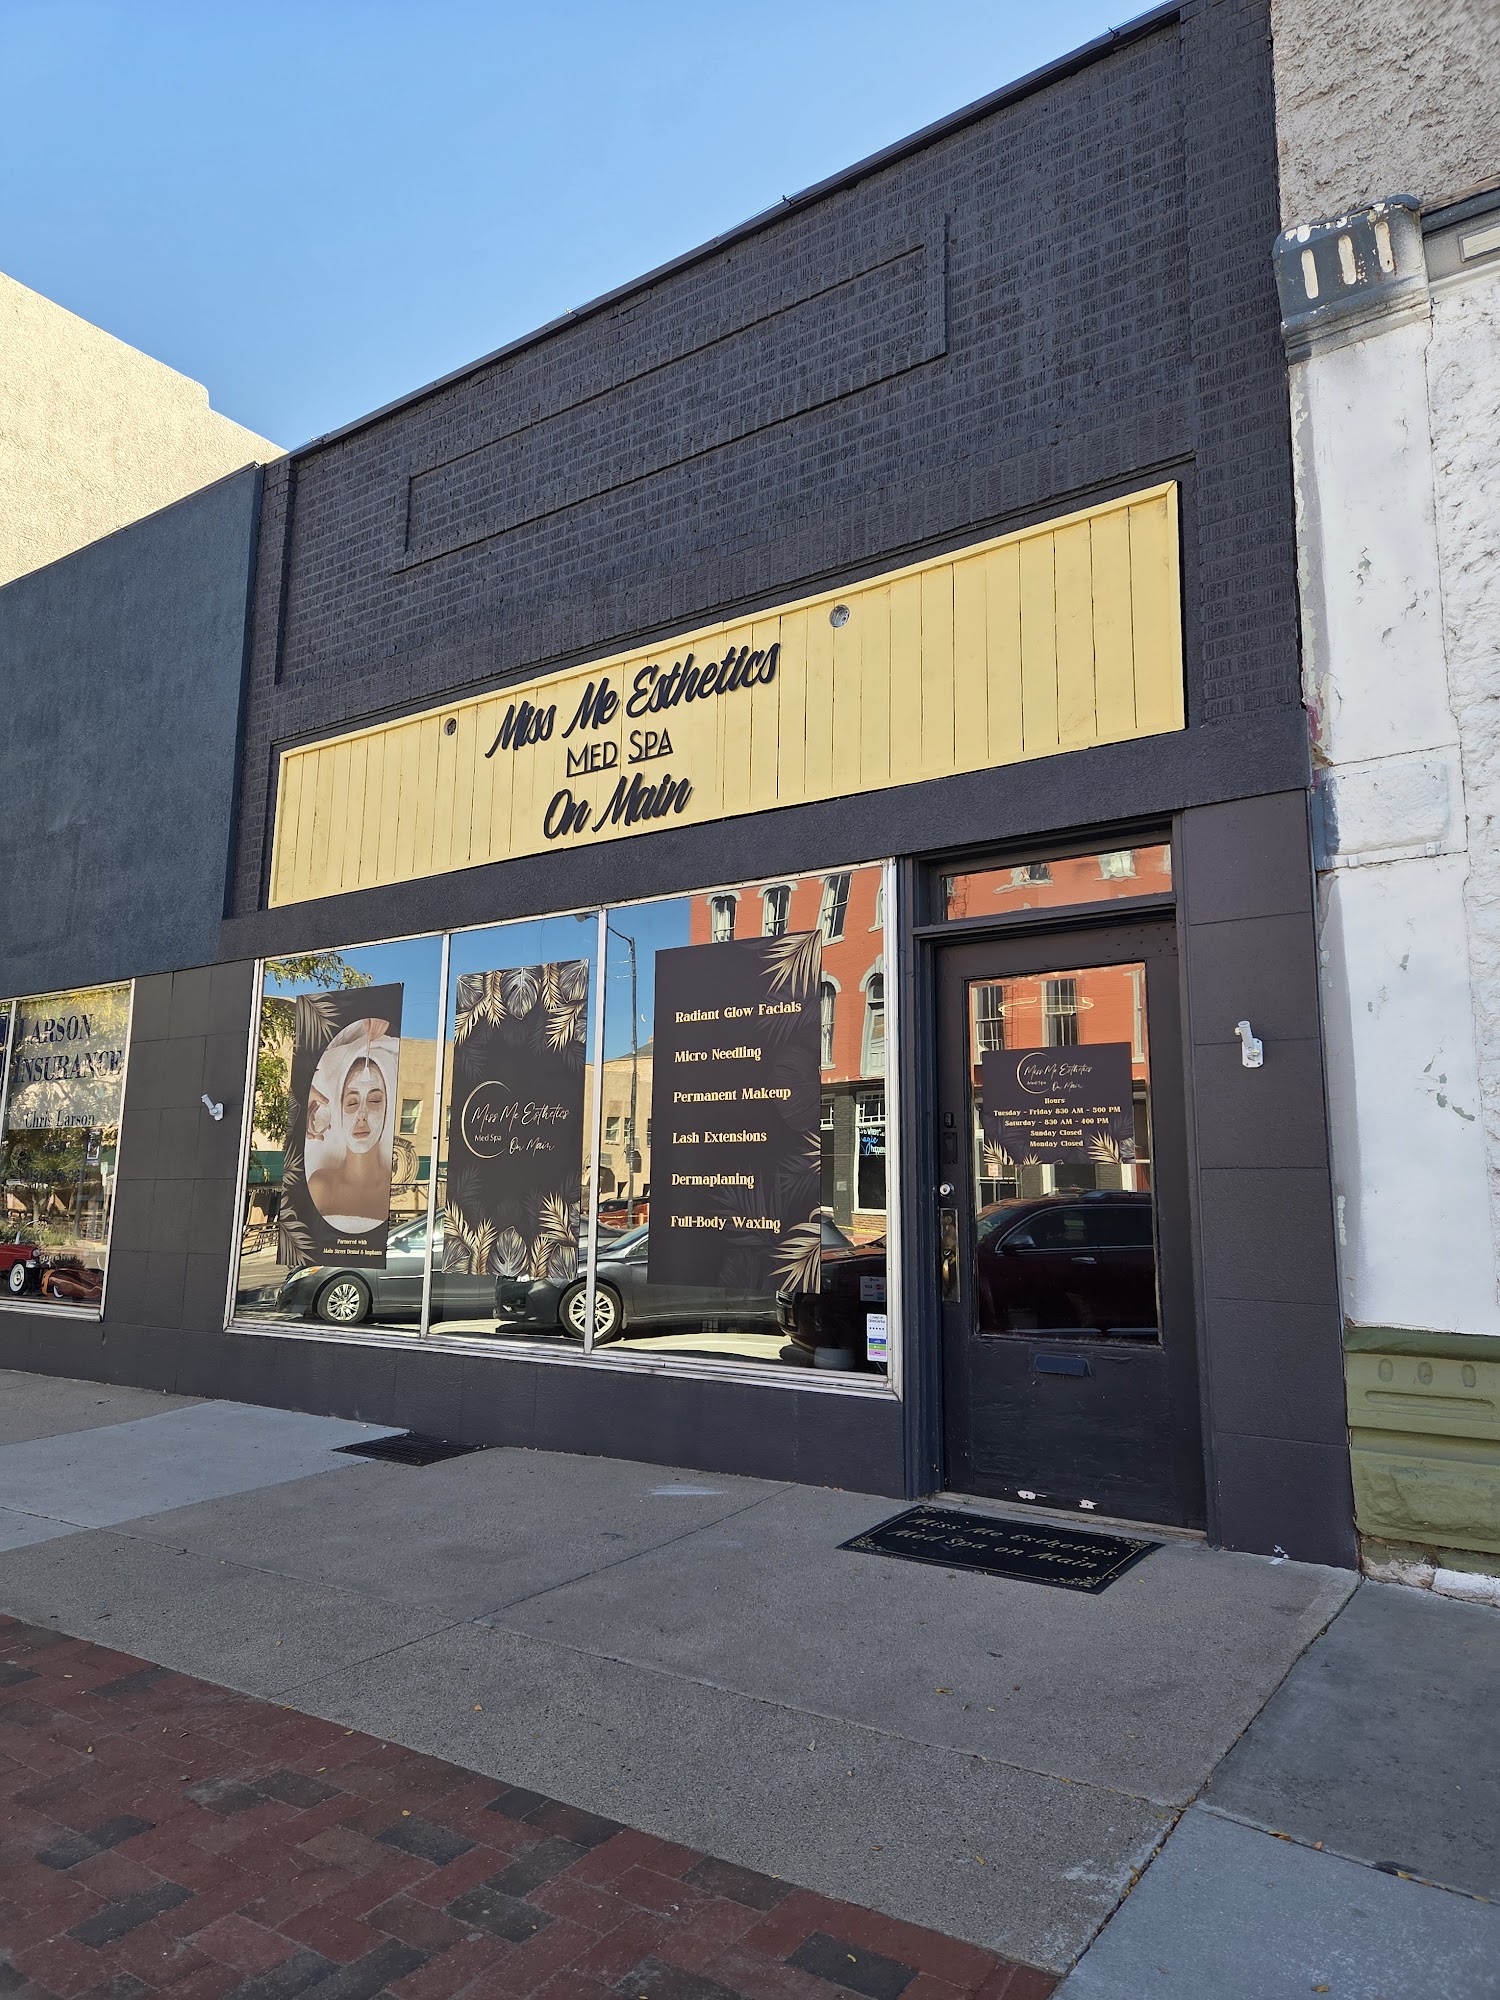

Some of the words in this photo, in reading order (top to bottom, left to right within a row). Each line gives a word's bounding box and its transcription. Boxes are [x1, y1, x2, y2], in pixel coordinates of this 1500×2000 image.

[485, 700, 556, 758] Miss
[562, 677, 620, 739] Me
[626, 642, 780, 718] Esthetics
[566, 740, 618, 777] MED
[628, 727, 673, 764] SPA
[543, 789, 591, 839] On
[592, 772, 692, 833] Main
[675, 1009, 719, 1022] Radiant
[724, 1006, 754, 1019] Glow
[758, 1001, 802, 1016] Facials
[17, 1014, 94, 1045] LARSON
[674, 1050, 708, 1062] Micro
[712, 1046, 762, 1062] Needling
[12, 1050, 122, 1084] INSURANCE
[1024, 1064, 1044, 1080] Miss
[673, 1090, 736, 1103] Permanent
[742, 1088, 791, 1101] Makeup
[1052, 1081, 1062, 1092] On
[25, 1110, 52, 1128] Chris
[56, 1110, 95, 1127] Larson
[471, 1103, 499, 1132] Miss
[500, 1102, 519, 1132] Me
[522, 1102, 570, 1125] Esthetics
[474, 1134, 489, 1142] Med
[490, 1134, 502, 1143] Spa
[509, 1136, 524, 1154] On
[526, 1137, 555, 1157] Main
[672, 1132, 700, 1144] Lash
[704, 1130, 767, 1143] Extensions
[672, 1173, 754, 1189] Dermaplaning
[671, 1216, 727, 1231] Full-Body
[732, 1216, 781, 1234] Waxing
[906, 1518, 961, 1530] Miss
[963, 1528, 1003, 1537] Me
[1010, 1534, 1118, 1556] Esthetics
[886, 1530, 946, 1541] Med
[945, 1536, 988, 1548] Spa
[1028, 1553, 1098, 1568] Main
